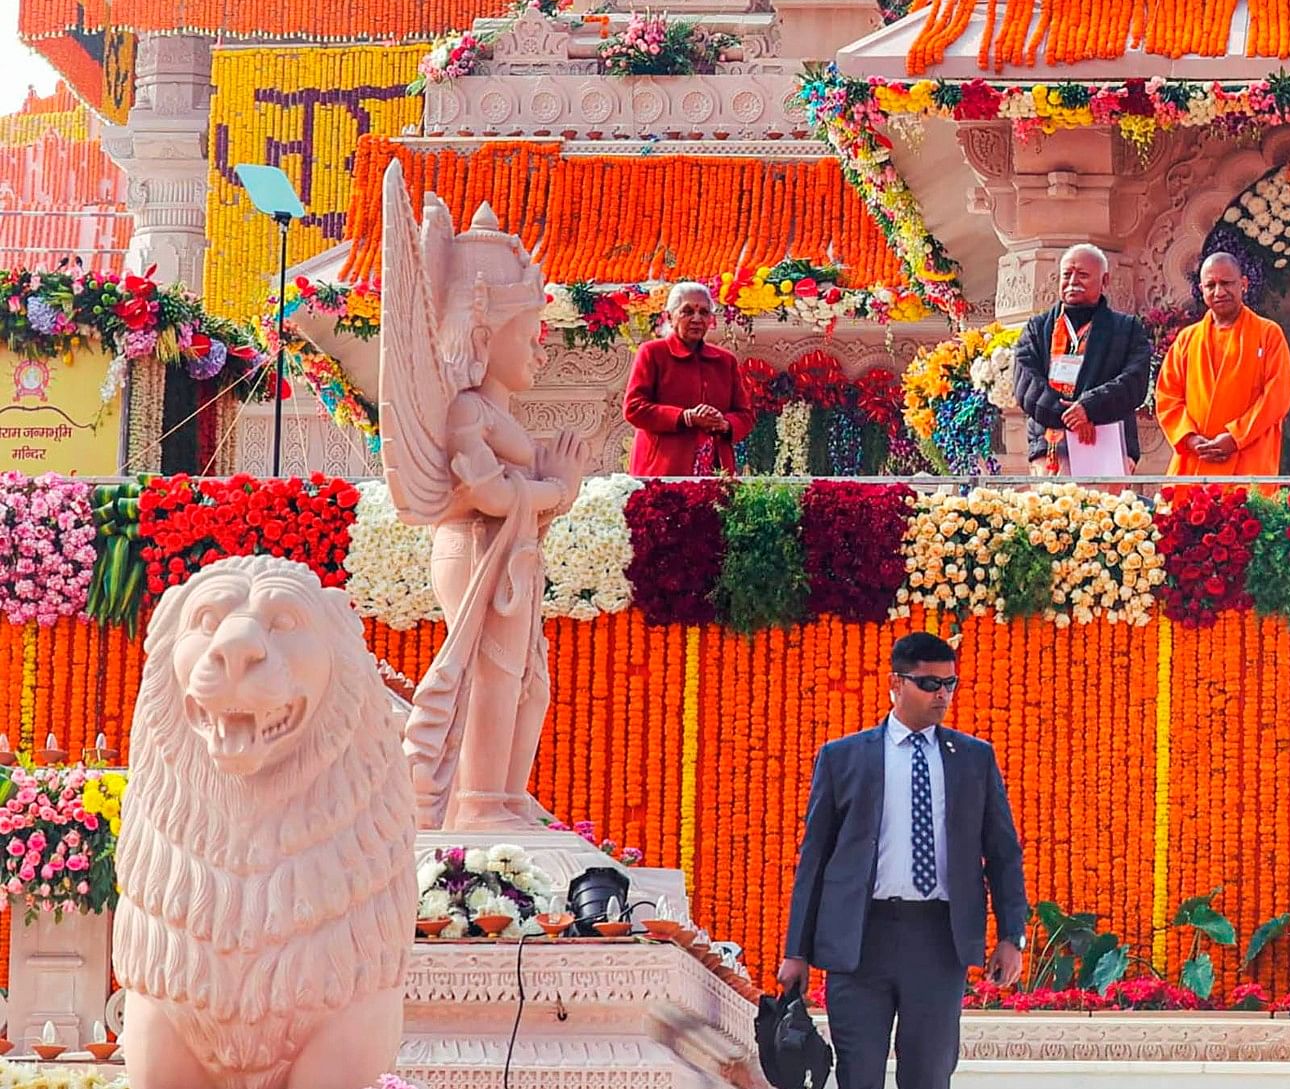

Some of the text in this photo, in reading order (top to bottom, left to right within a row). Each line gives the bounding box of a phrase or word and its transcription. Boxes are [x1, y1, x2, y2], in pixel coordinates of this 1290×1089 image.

[0, 423, 73, 442] राम जन्मभूमि
[11, 445, 47, 460] मन्दिर
